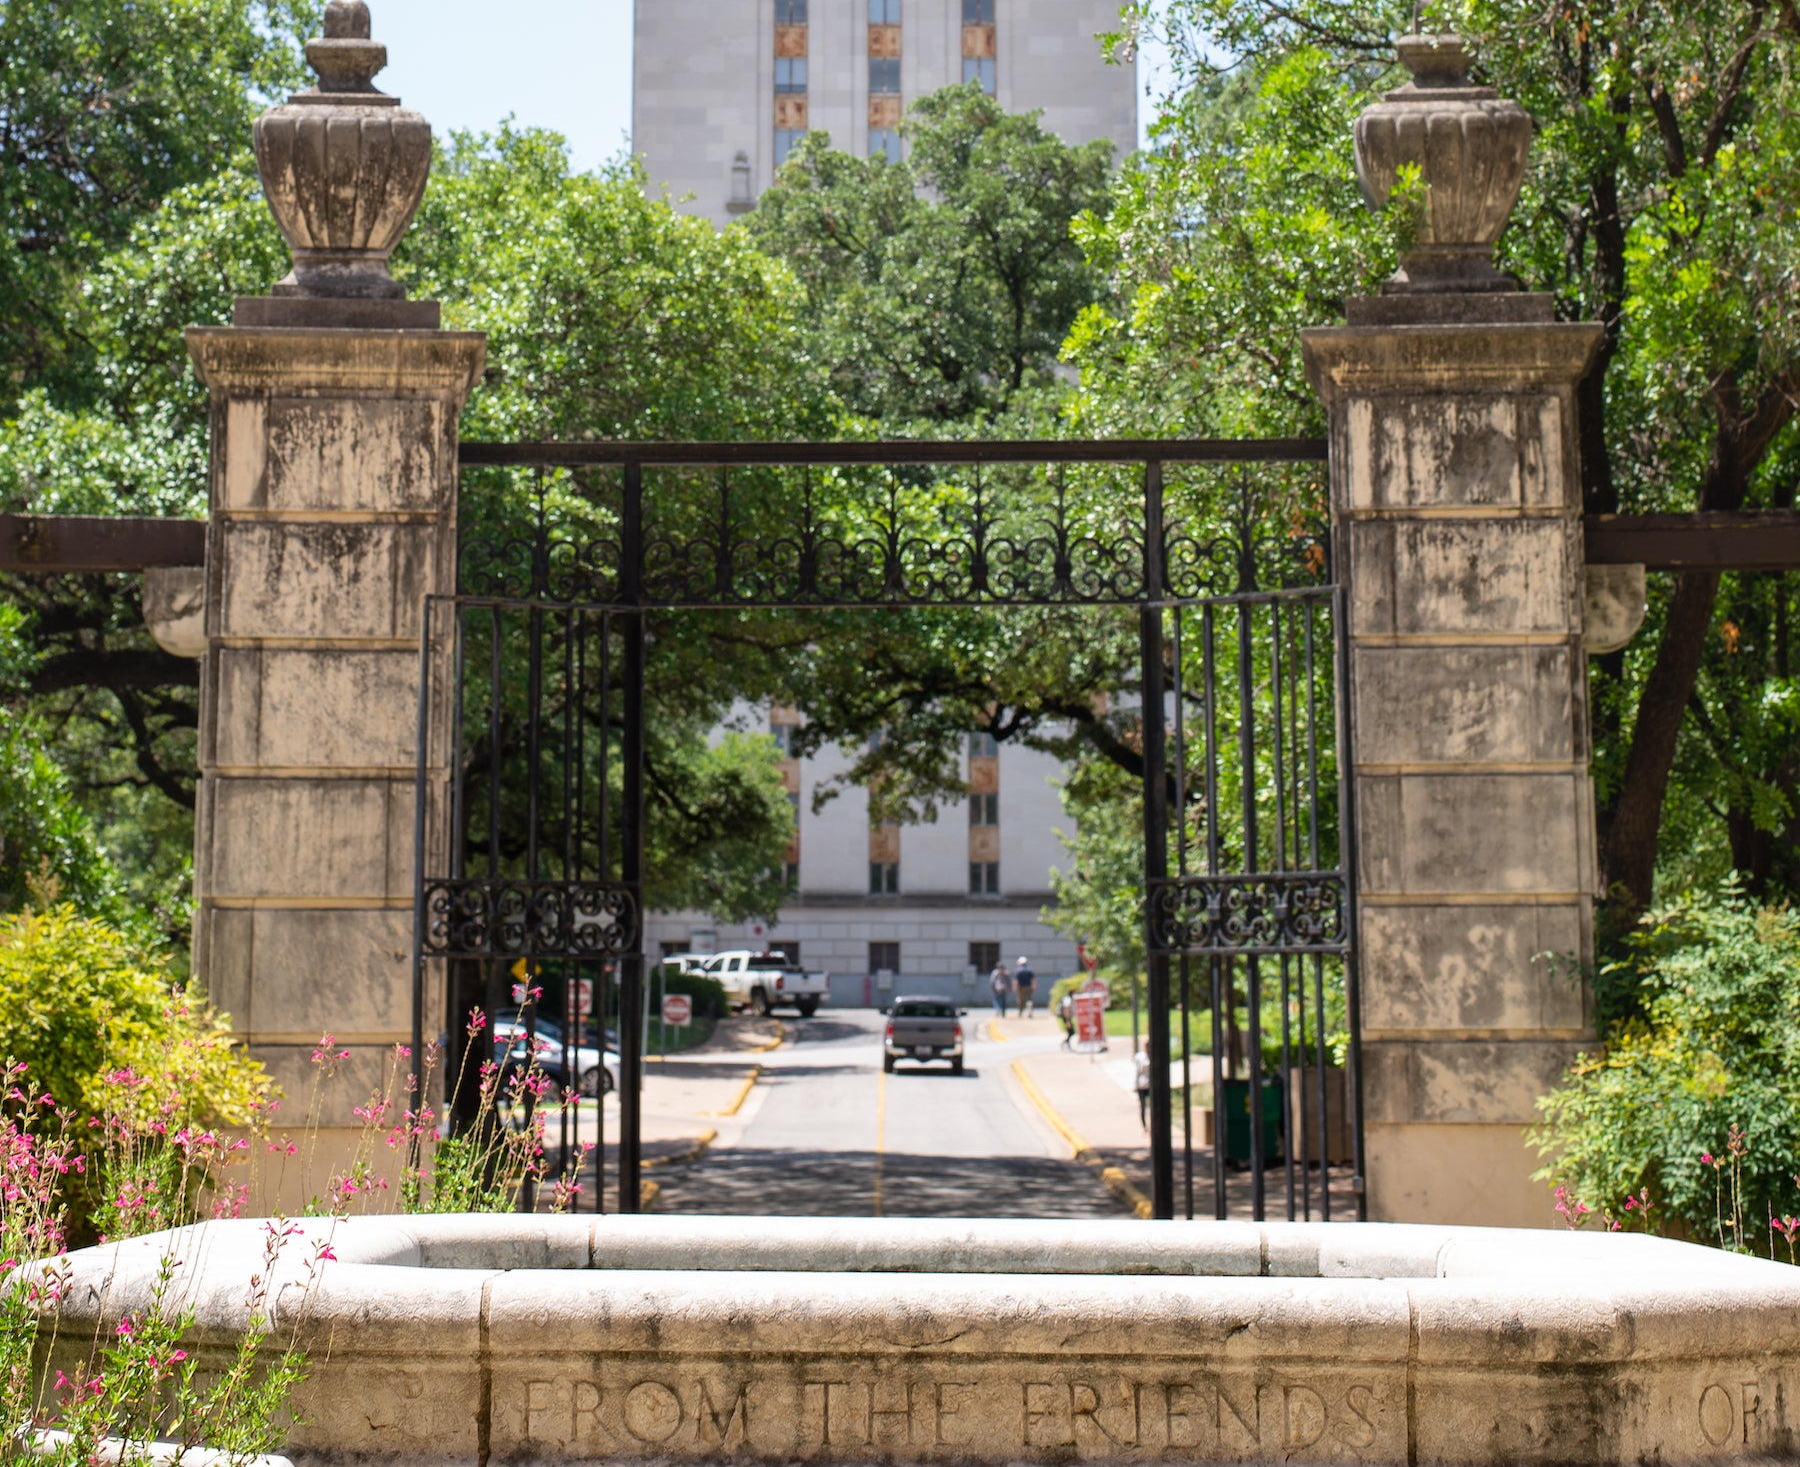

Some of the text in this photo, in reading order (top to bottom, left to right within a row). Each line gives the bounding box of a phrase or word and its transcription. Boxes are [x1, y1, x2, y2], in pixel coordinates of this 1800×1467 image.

[521, 1380, 1375, 1448] FROM THE FRIENDS
[1699, 1382, 1761, 1446] OF
